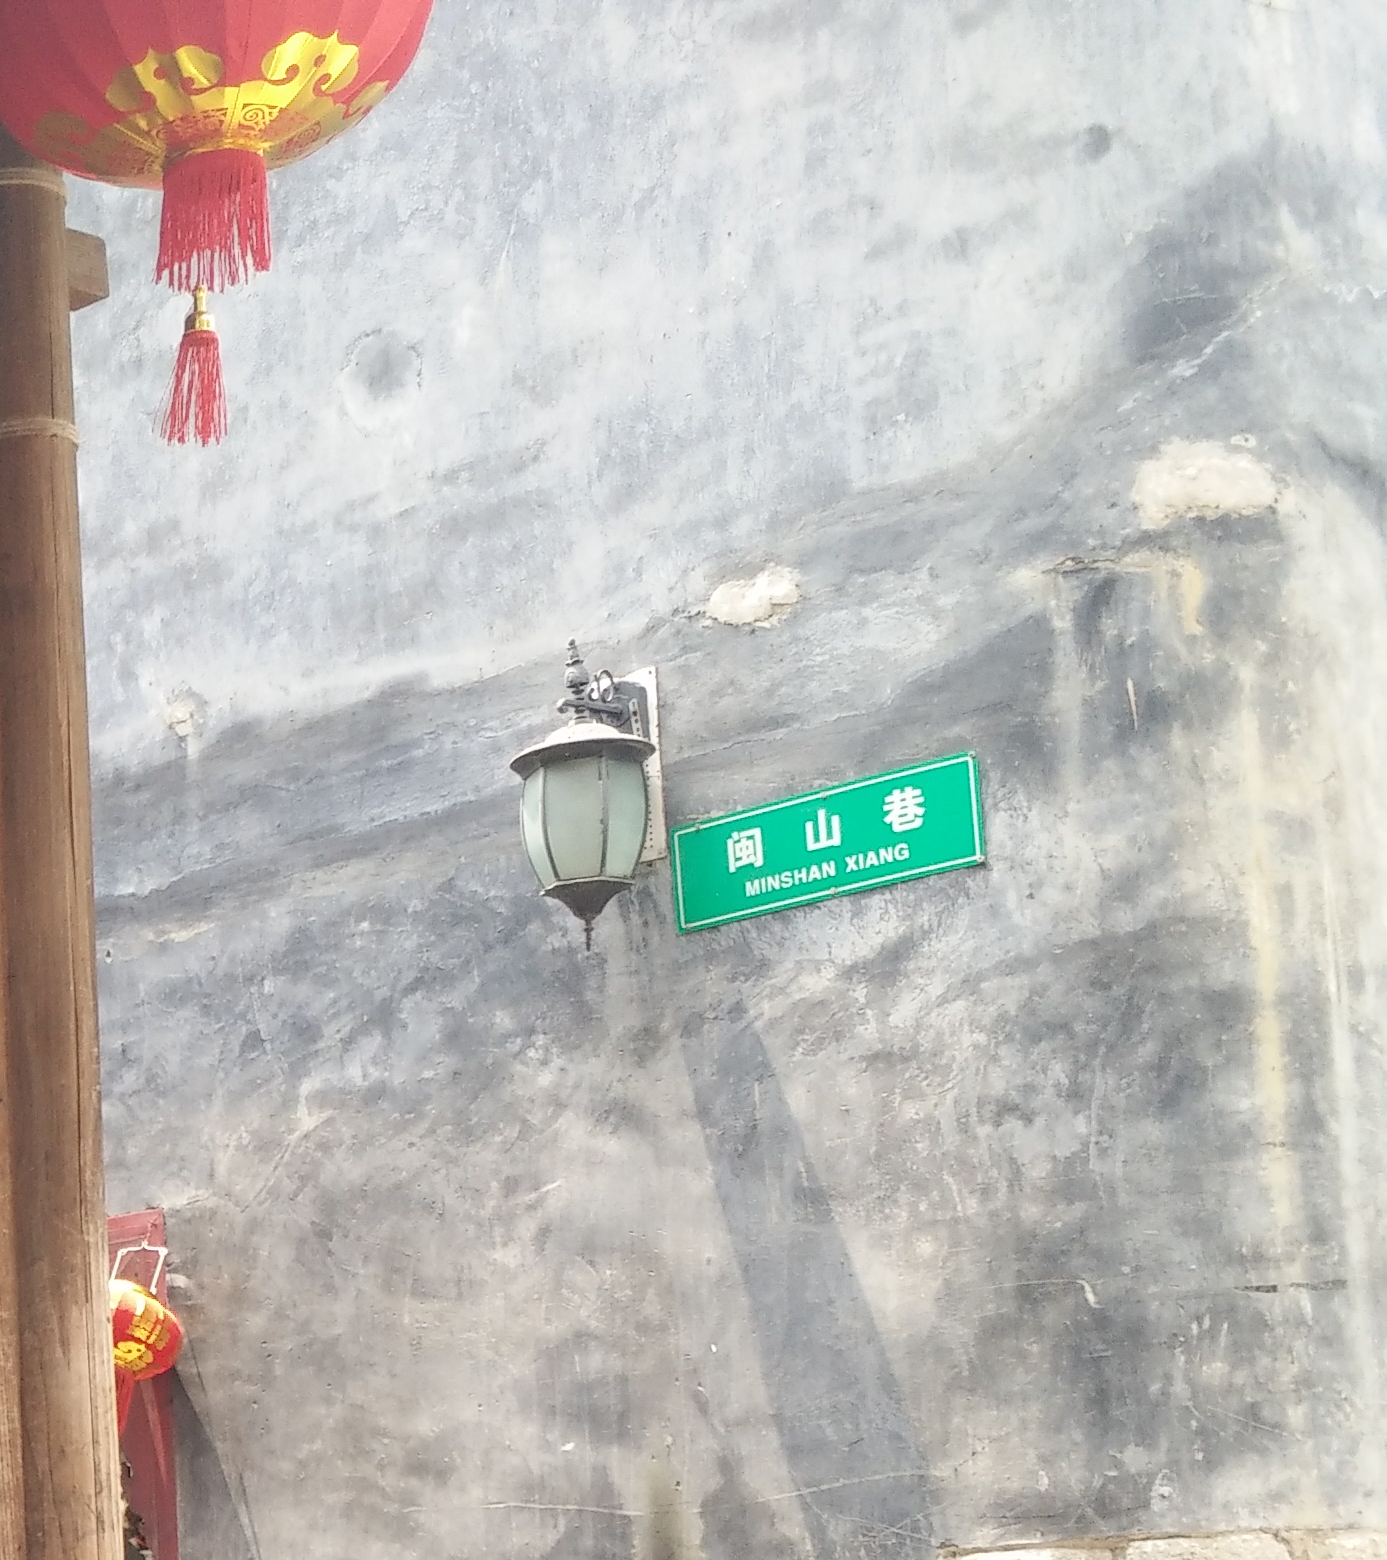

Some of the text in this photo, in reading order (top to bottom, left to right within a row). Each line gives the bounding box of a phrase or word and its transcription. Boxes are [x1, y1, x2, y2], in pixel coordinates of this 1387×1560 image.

[727, 786, 926, 873] 闽山巷
[745, 842, 910, 898] MINSHAN XIANG
